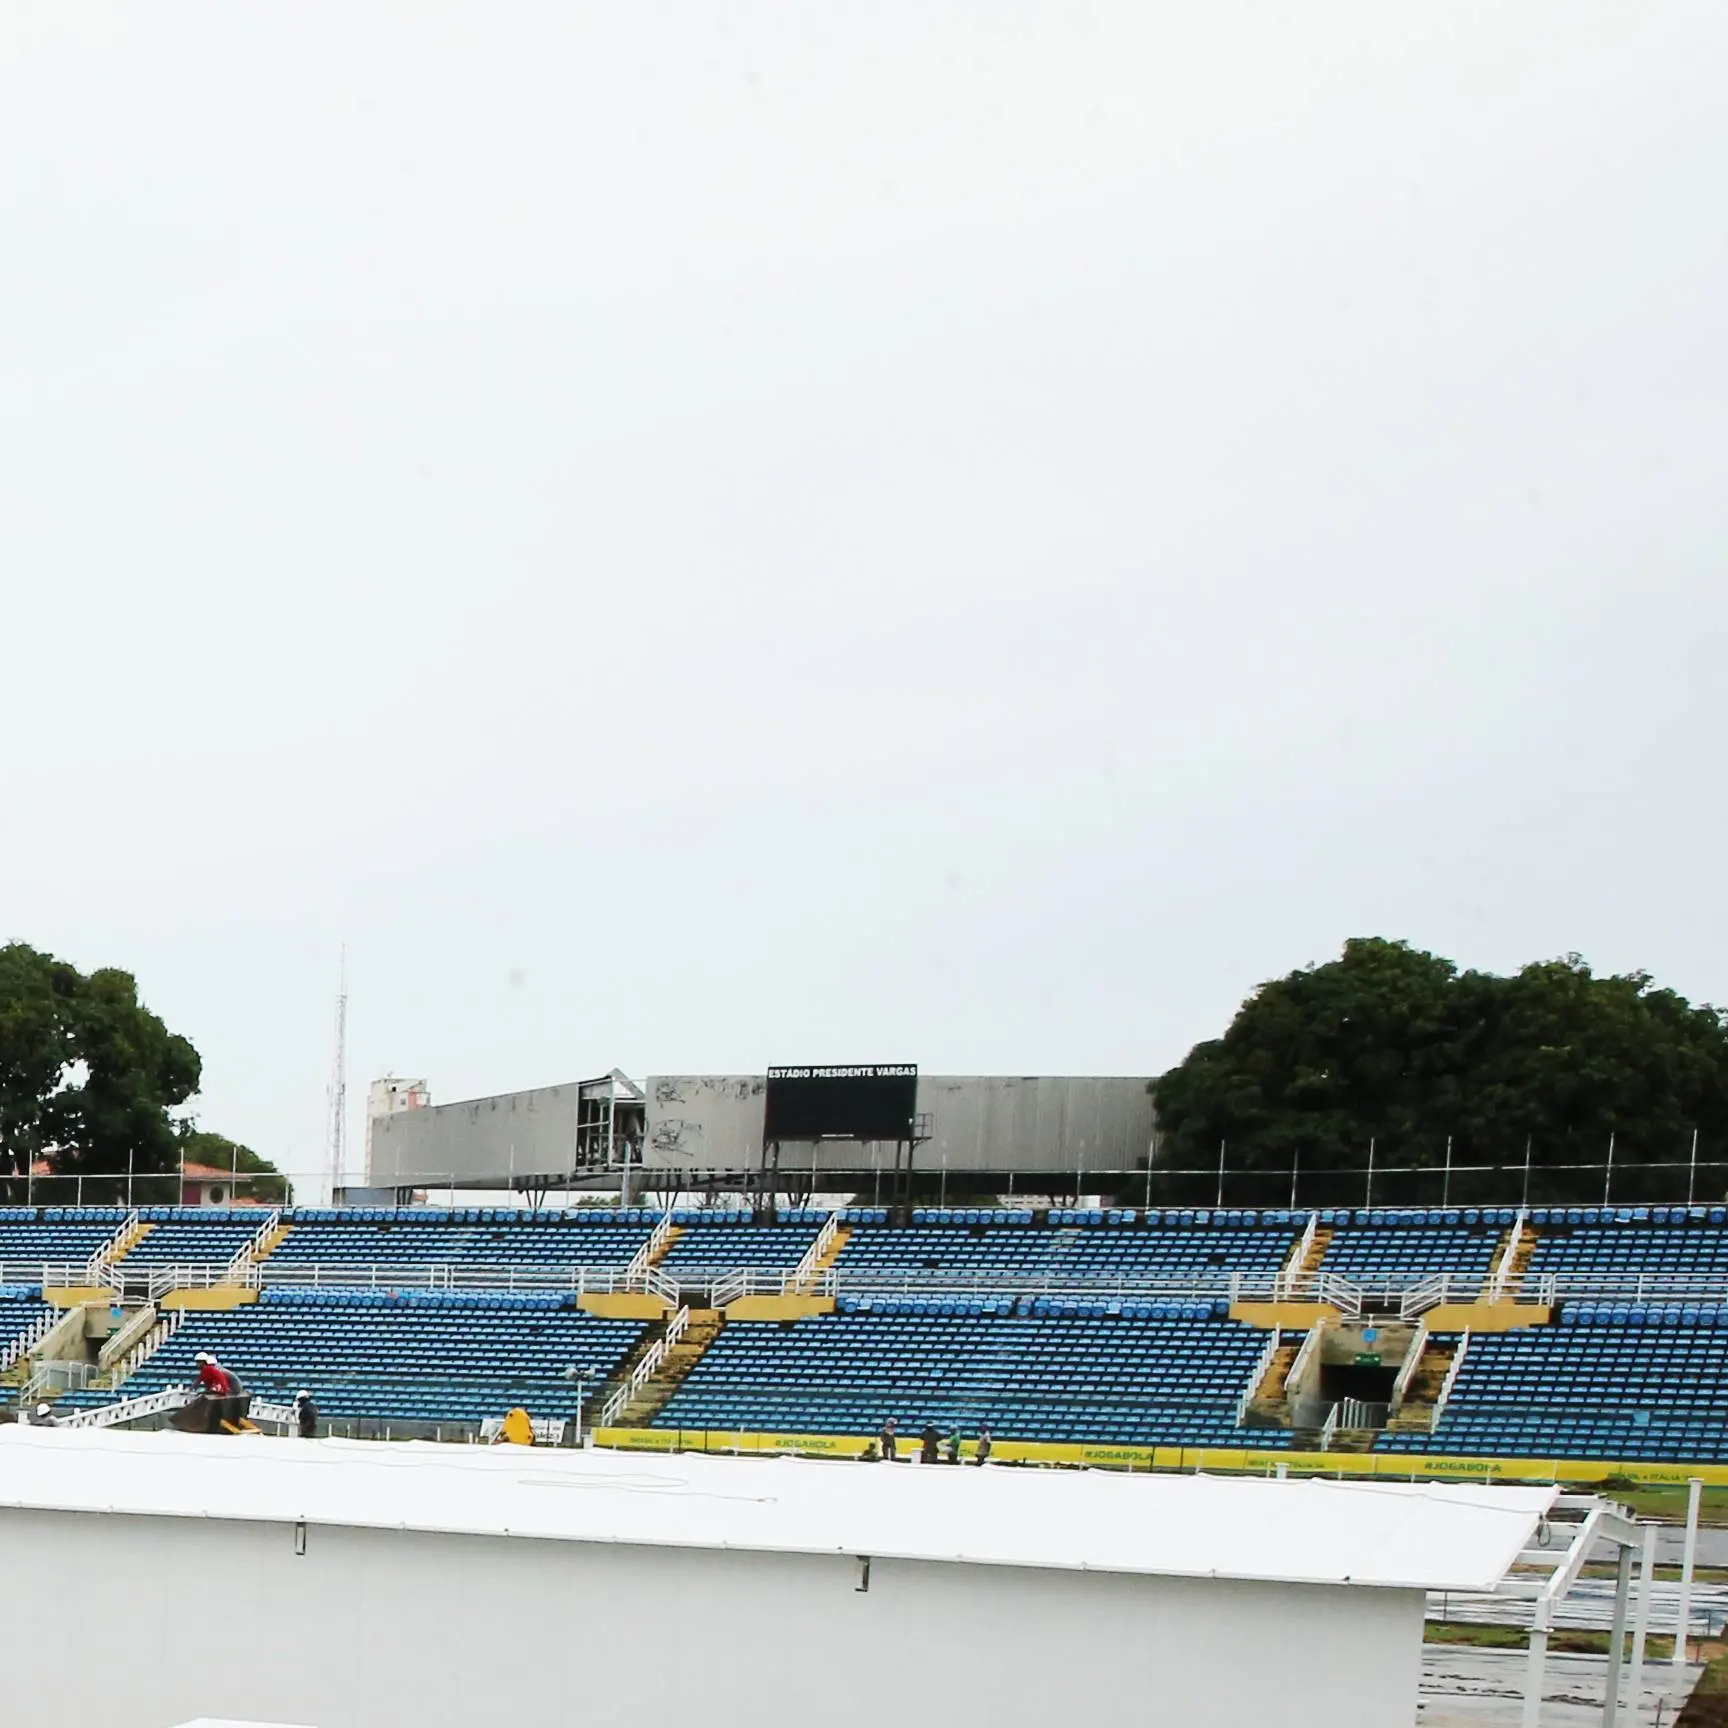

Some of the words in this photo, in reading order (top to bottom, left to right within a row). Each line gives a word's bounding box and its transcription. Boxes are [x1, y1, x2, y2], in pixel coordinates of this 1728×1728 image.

[768, 1067, 811, 1079] ESTÁDIO
[812, 1066, 874, 1078] PRESIDENTE
[876, 1065, 917, 1077] VARGAS
